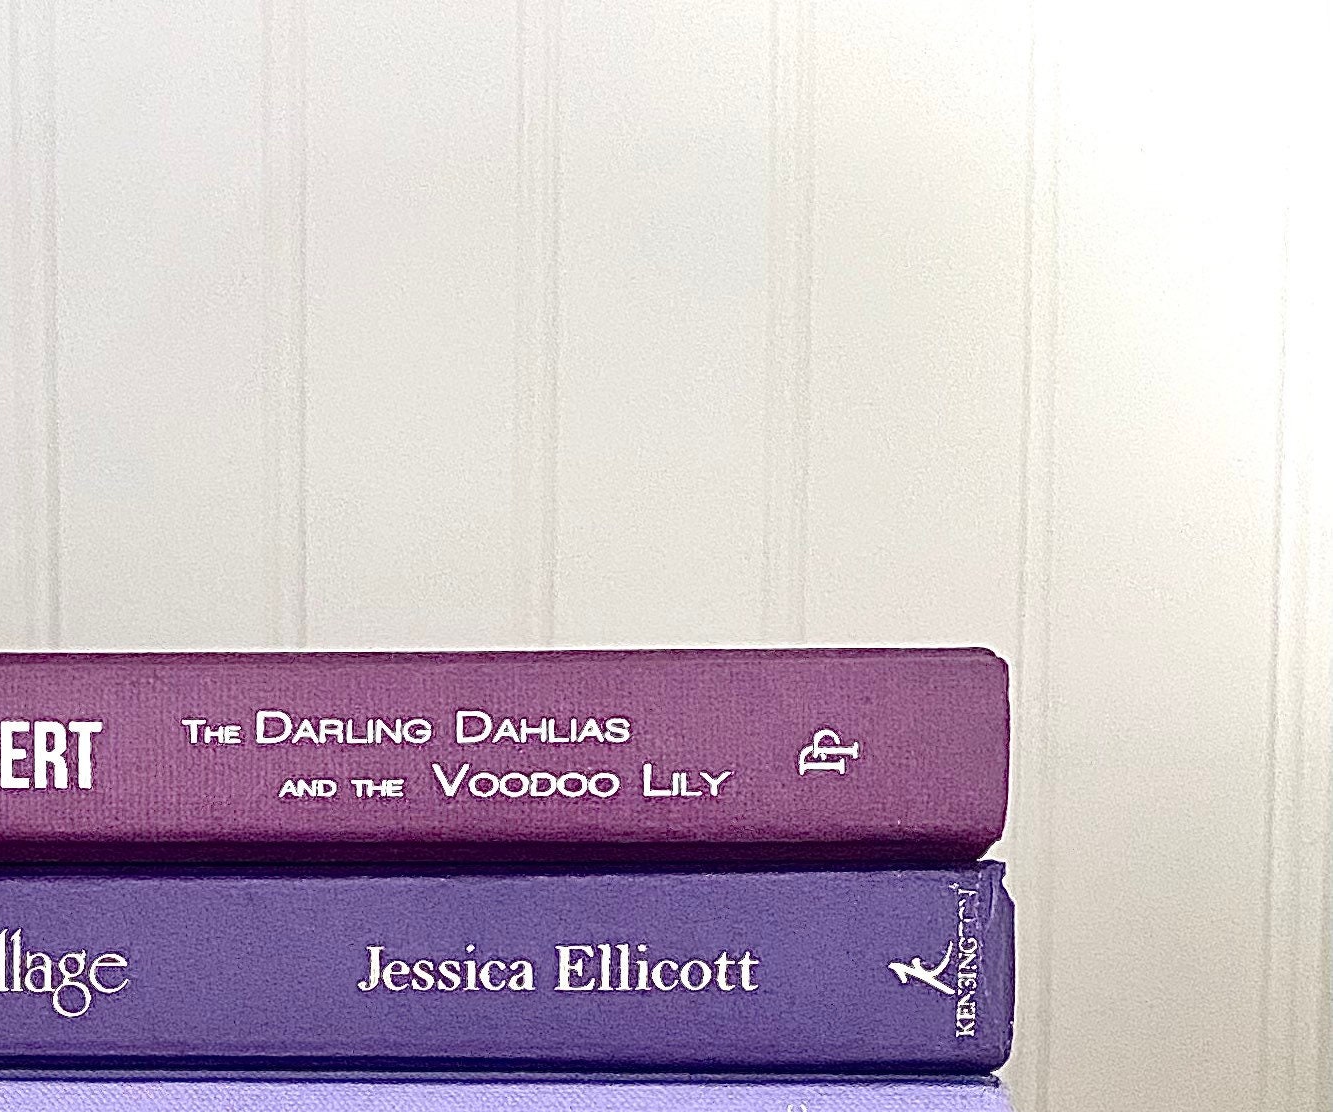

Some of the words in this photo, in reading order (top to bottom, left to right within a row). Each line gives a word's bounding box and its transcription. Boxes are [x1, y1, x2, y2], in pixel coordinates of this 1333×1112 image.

[181, 718, 241, 744] THE
[255, 711, 432, 744] DARLING
[456, 711, 631, 744] DAHLIAS
[432, 764, 620, 798] VOODOO
[643, 764, 732, 797] LILY
[357, 944, 536, 991] Jessica
[554, 944, 760, 991] Ellicott
